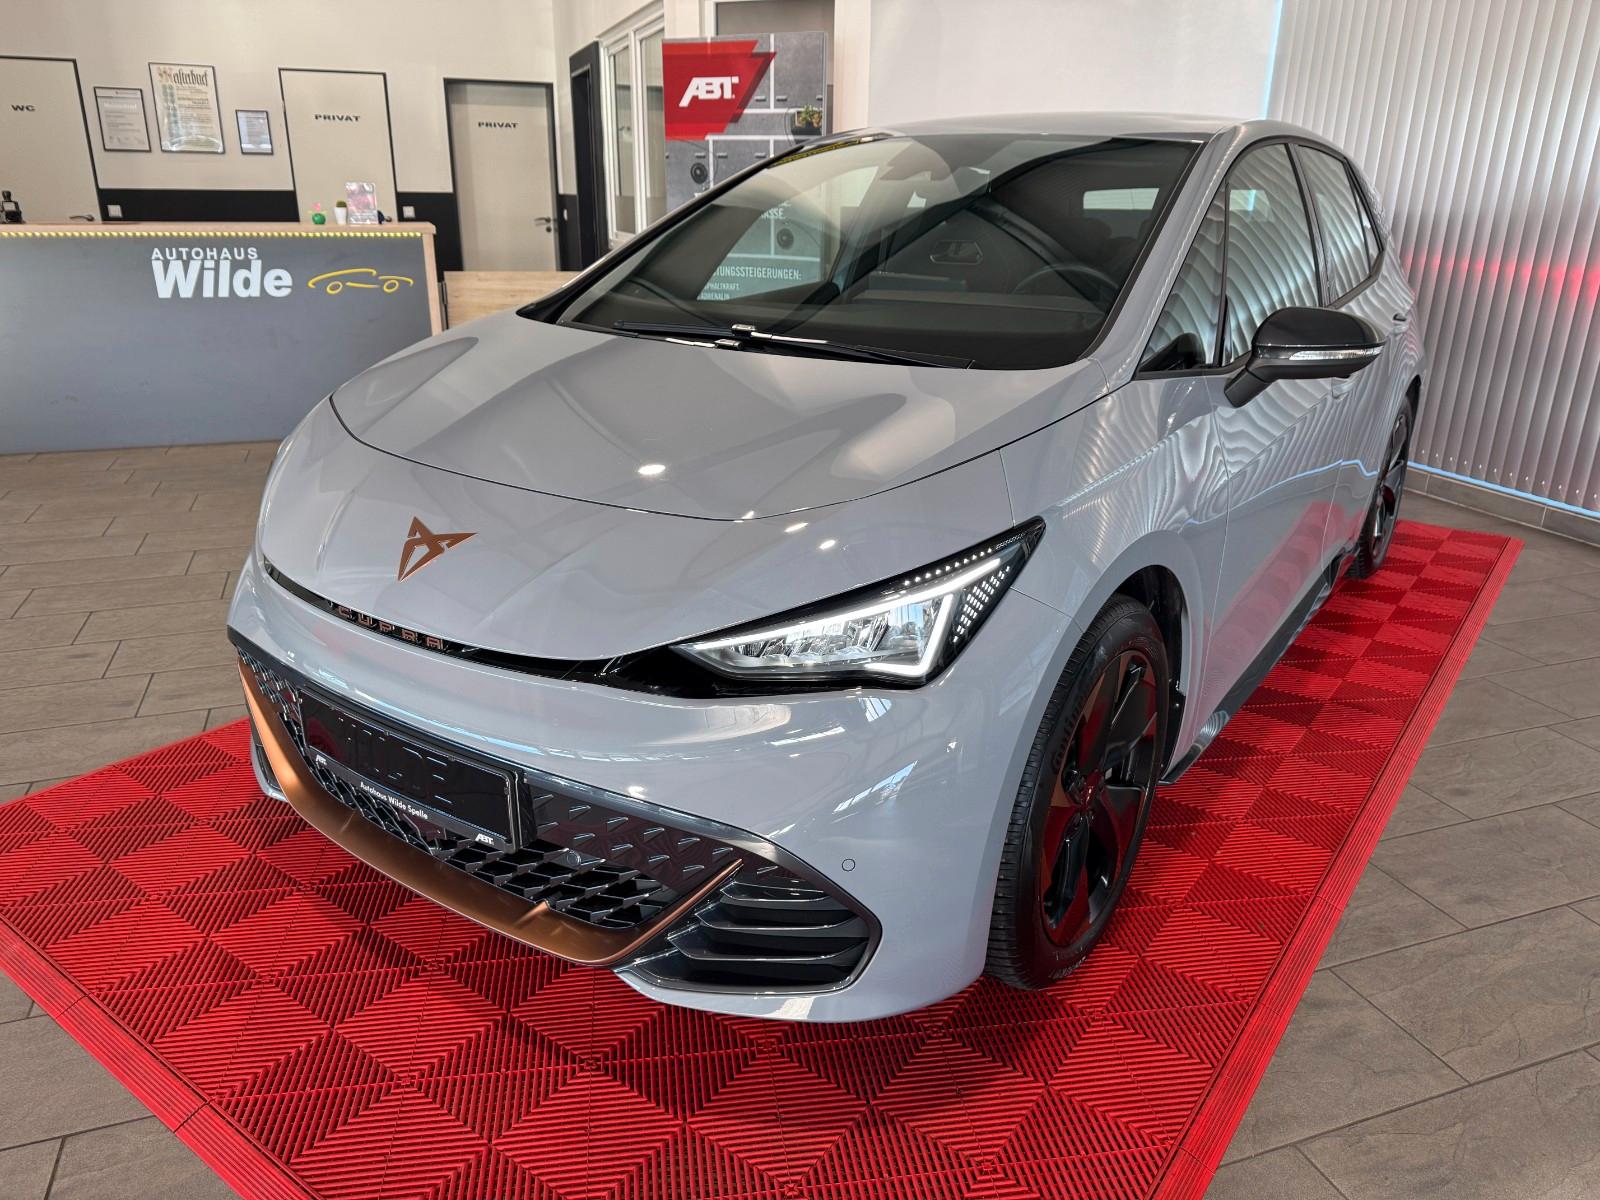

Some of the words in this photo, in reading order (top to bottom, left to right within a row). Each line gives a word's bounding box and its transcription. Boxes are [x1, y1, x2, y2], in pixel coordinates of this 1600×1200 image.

[679, 76, 739, 107] ABT
[11, 104, 36, 112] WC
[314, 114, 361, 122] PRIVAT
[151, 247, 258, 260] AUTOHAUS
[151, 259, 293, 298] Wilde
[338, 605, 444, 650] CUPRA
[360, 781, 388, 801] Autohaus
[388, 795, 407, 811] Wilde
